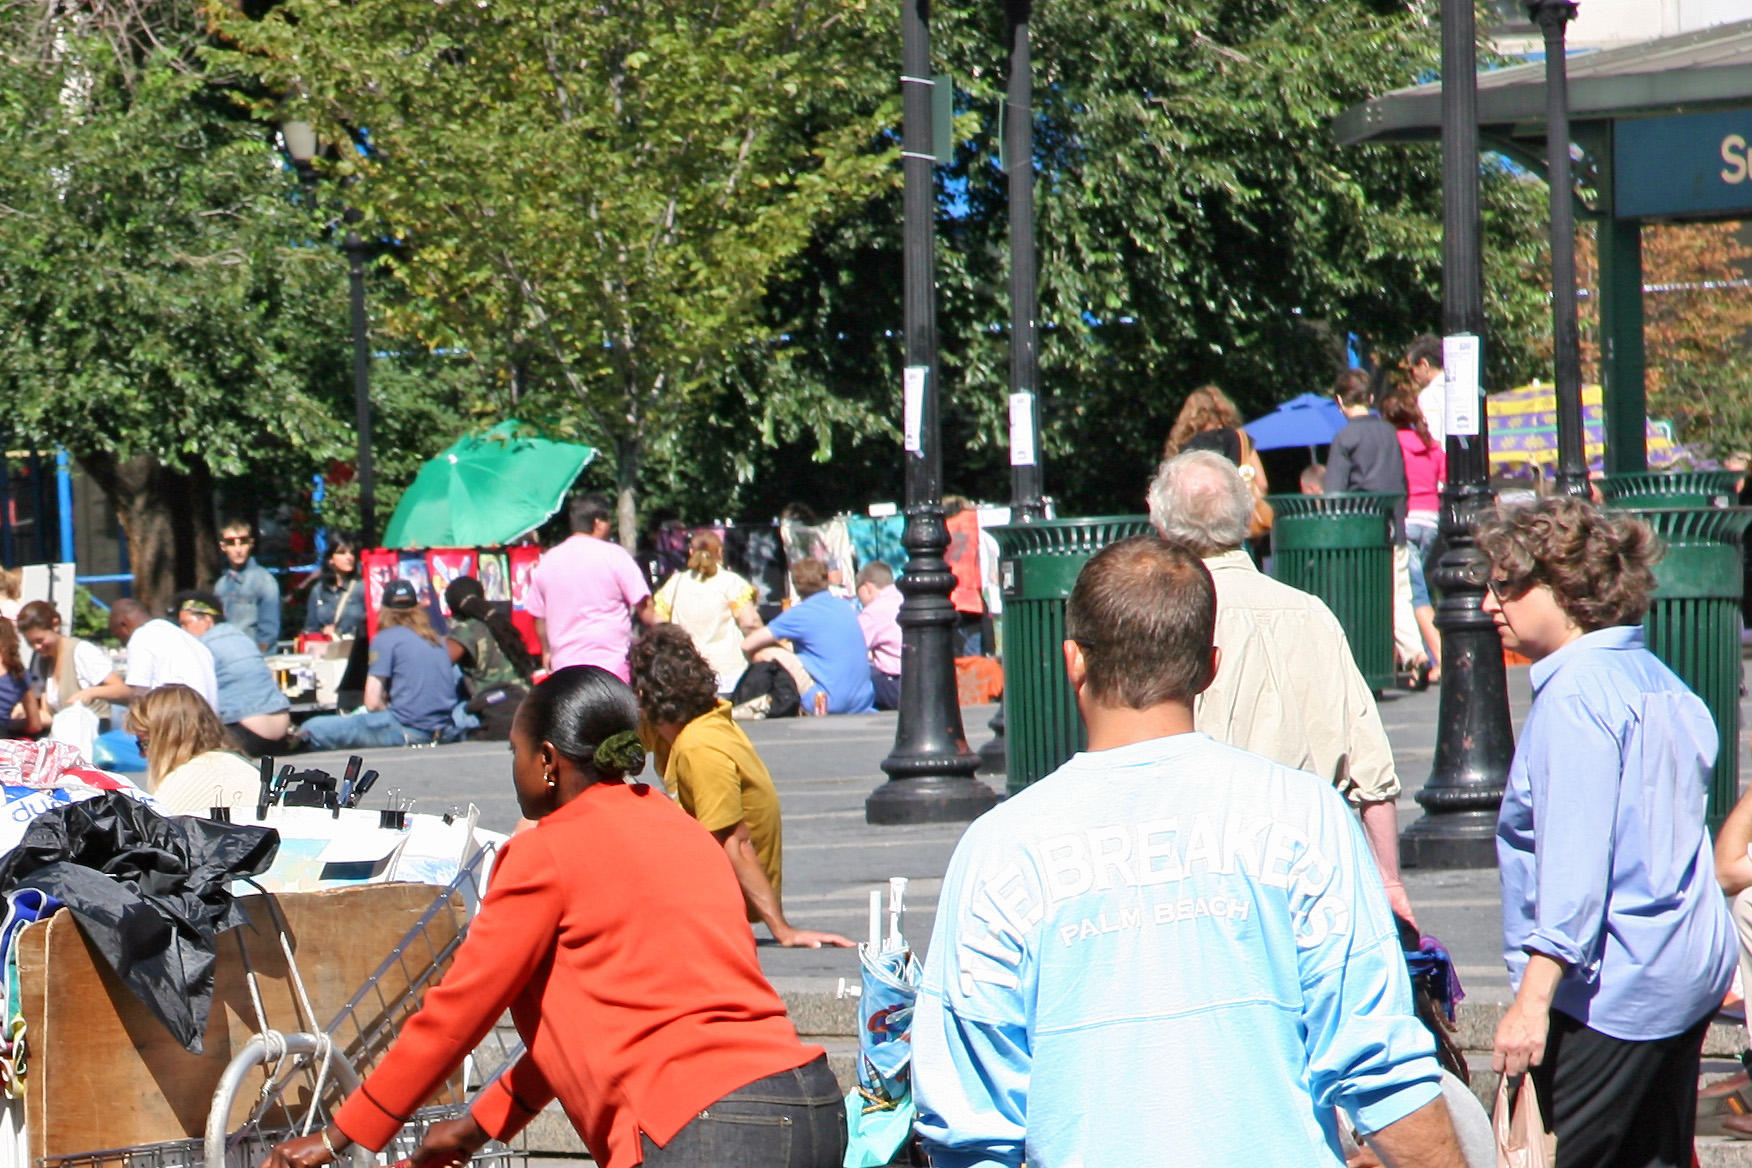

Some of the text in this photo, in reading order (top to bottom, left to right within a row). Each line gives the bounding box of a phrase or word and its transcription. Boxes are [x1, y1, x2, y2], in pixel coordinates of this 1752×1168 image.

[1720, 133, 1752, 184] S
[959, 811, 1349, 998] THE BREAKERS
[1059, 895, 1251, 947] PALM BEACH
